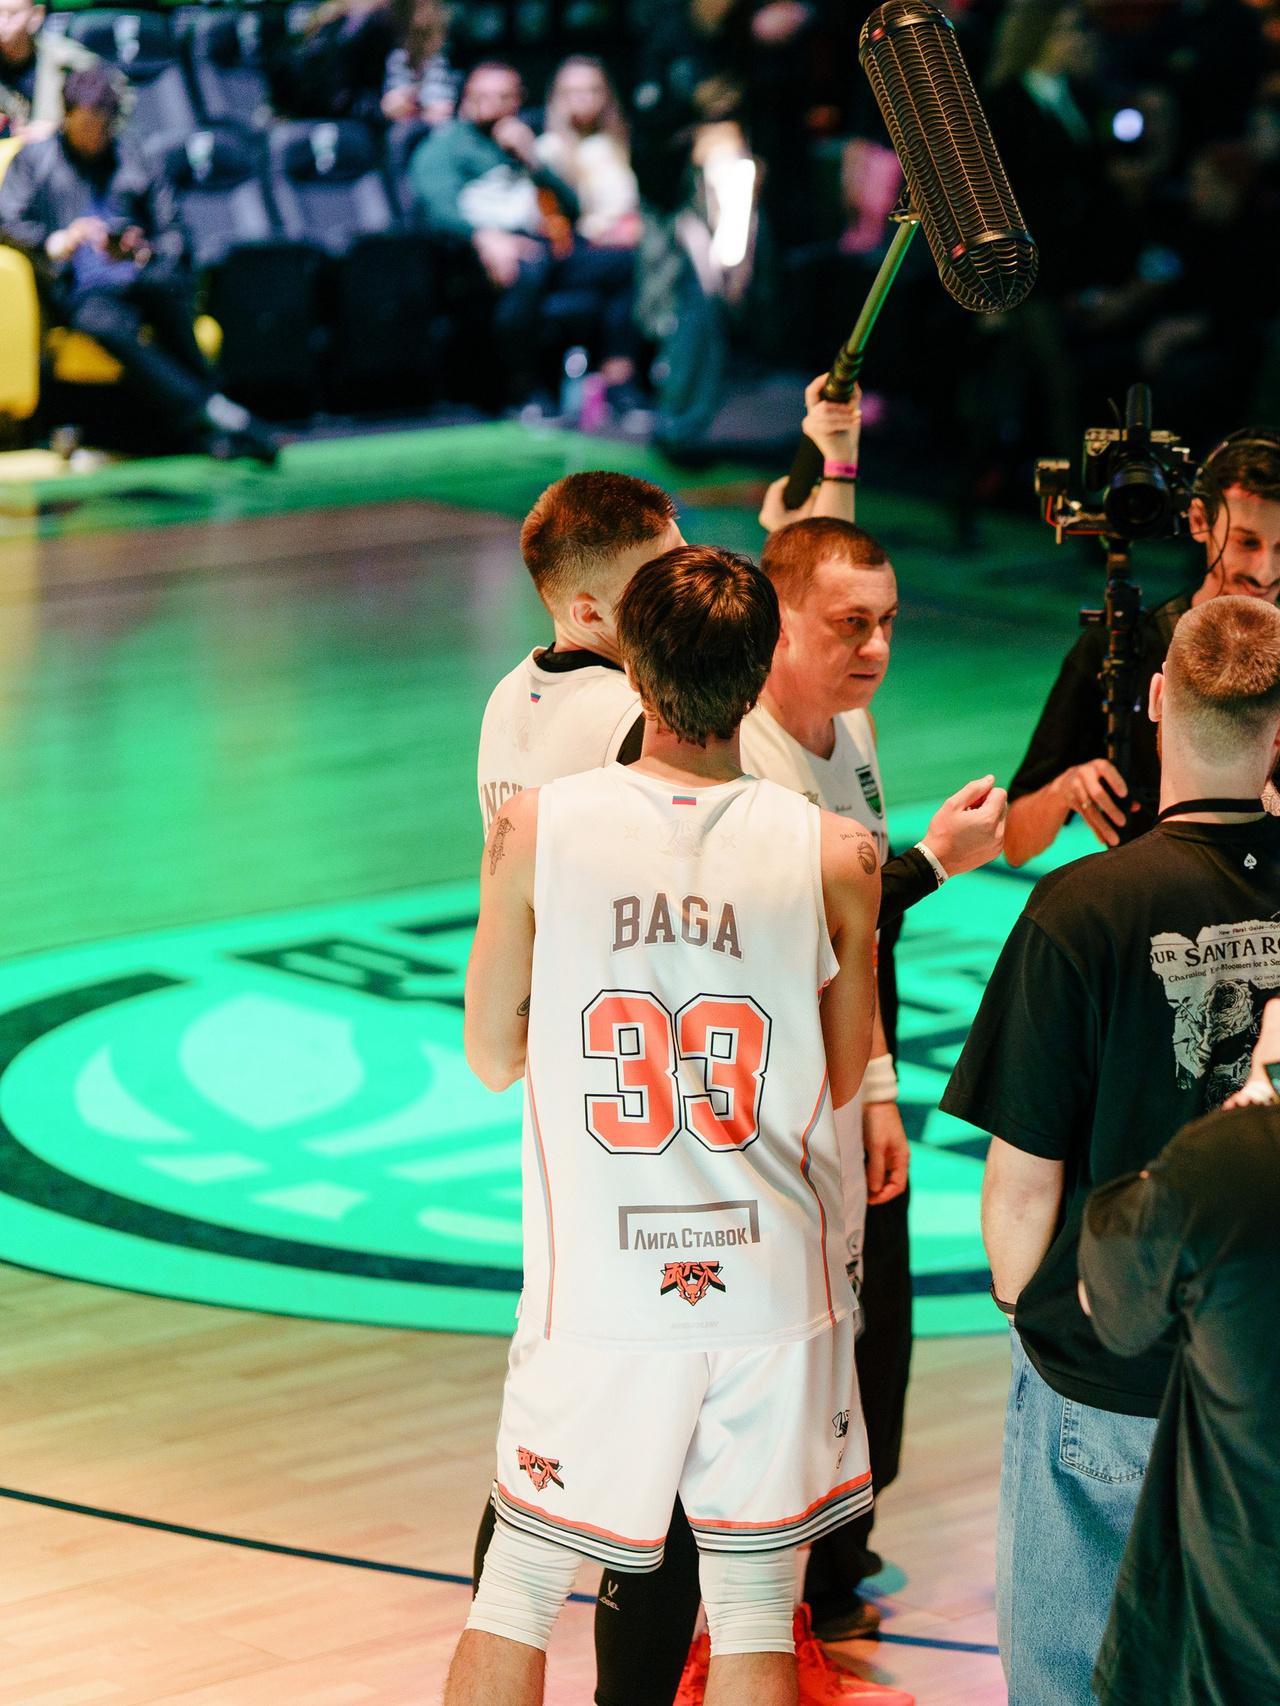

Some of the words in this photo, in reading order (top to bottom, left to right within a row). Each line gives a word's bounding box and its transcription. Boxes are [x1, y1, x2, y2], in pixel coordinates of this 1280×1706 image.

[611, 891, 743, 960] BAGA
[1168, 969, 1206, 983] Charming
[1253, 960, 1262, 968] for
[1185, 938, 1256, 967] SANTA
[582, 989, 772, 1155] 33
